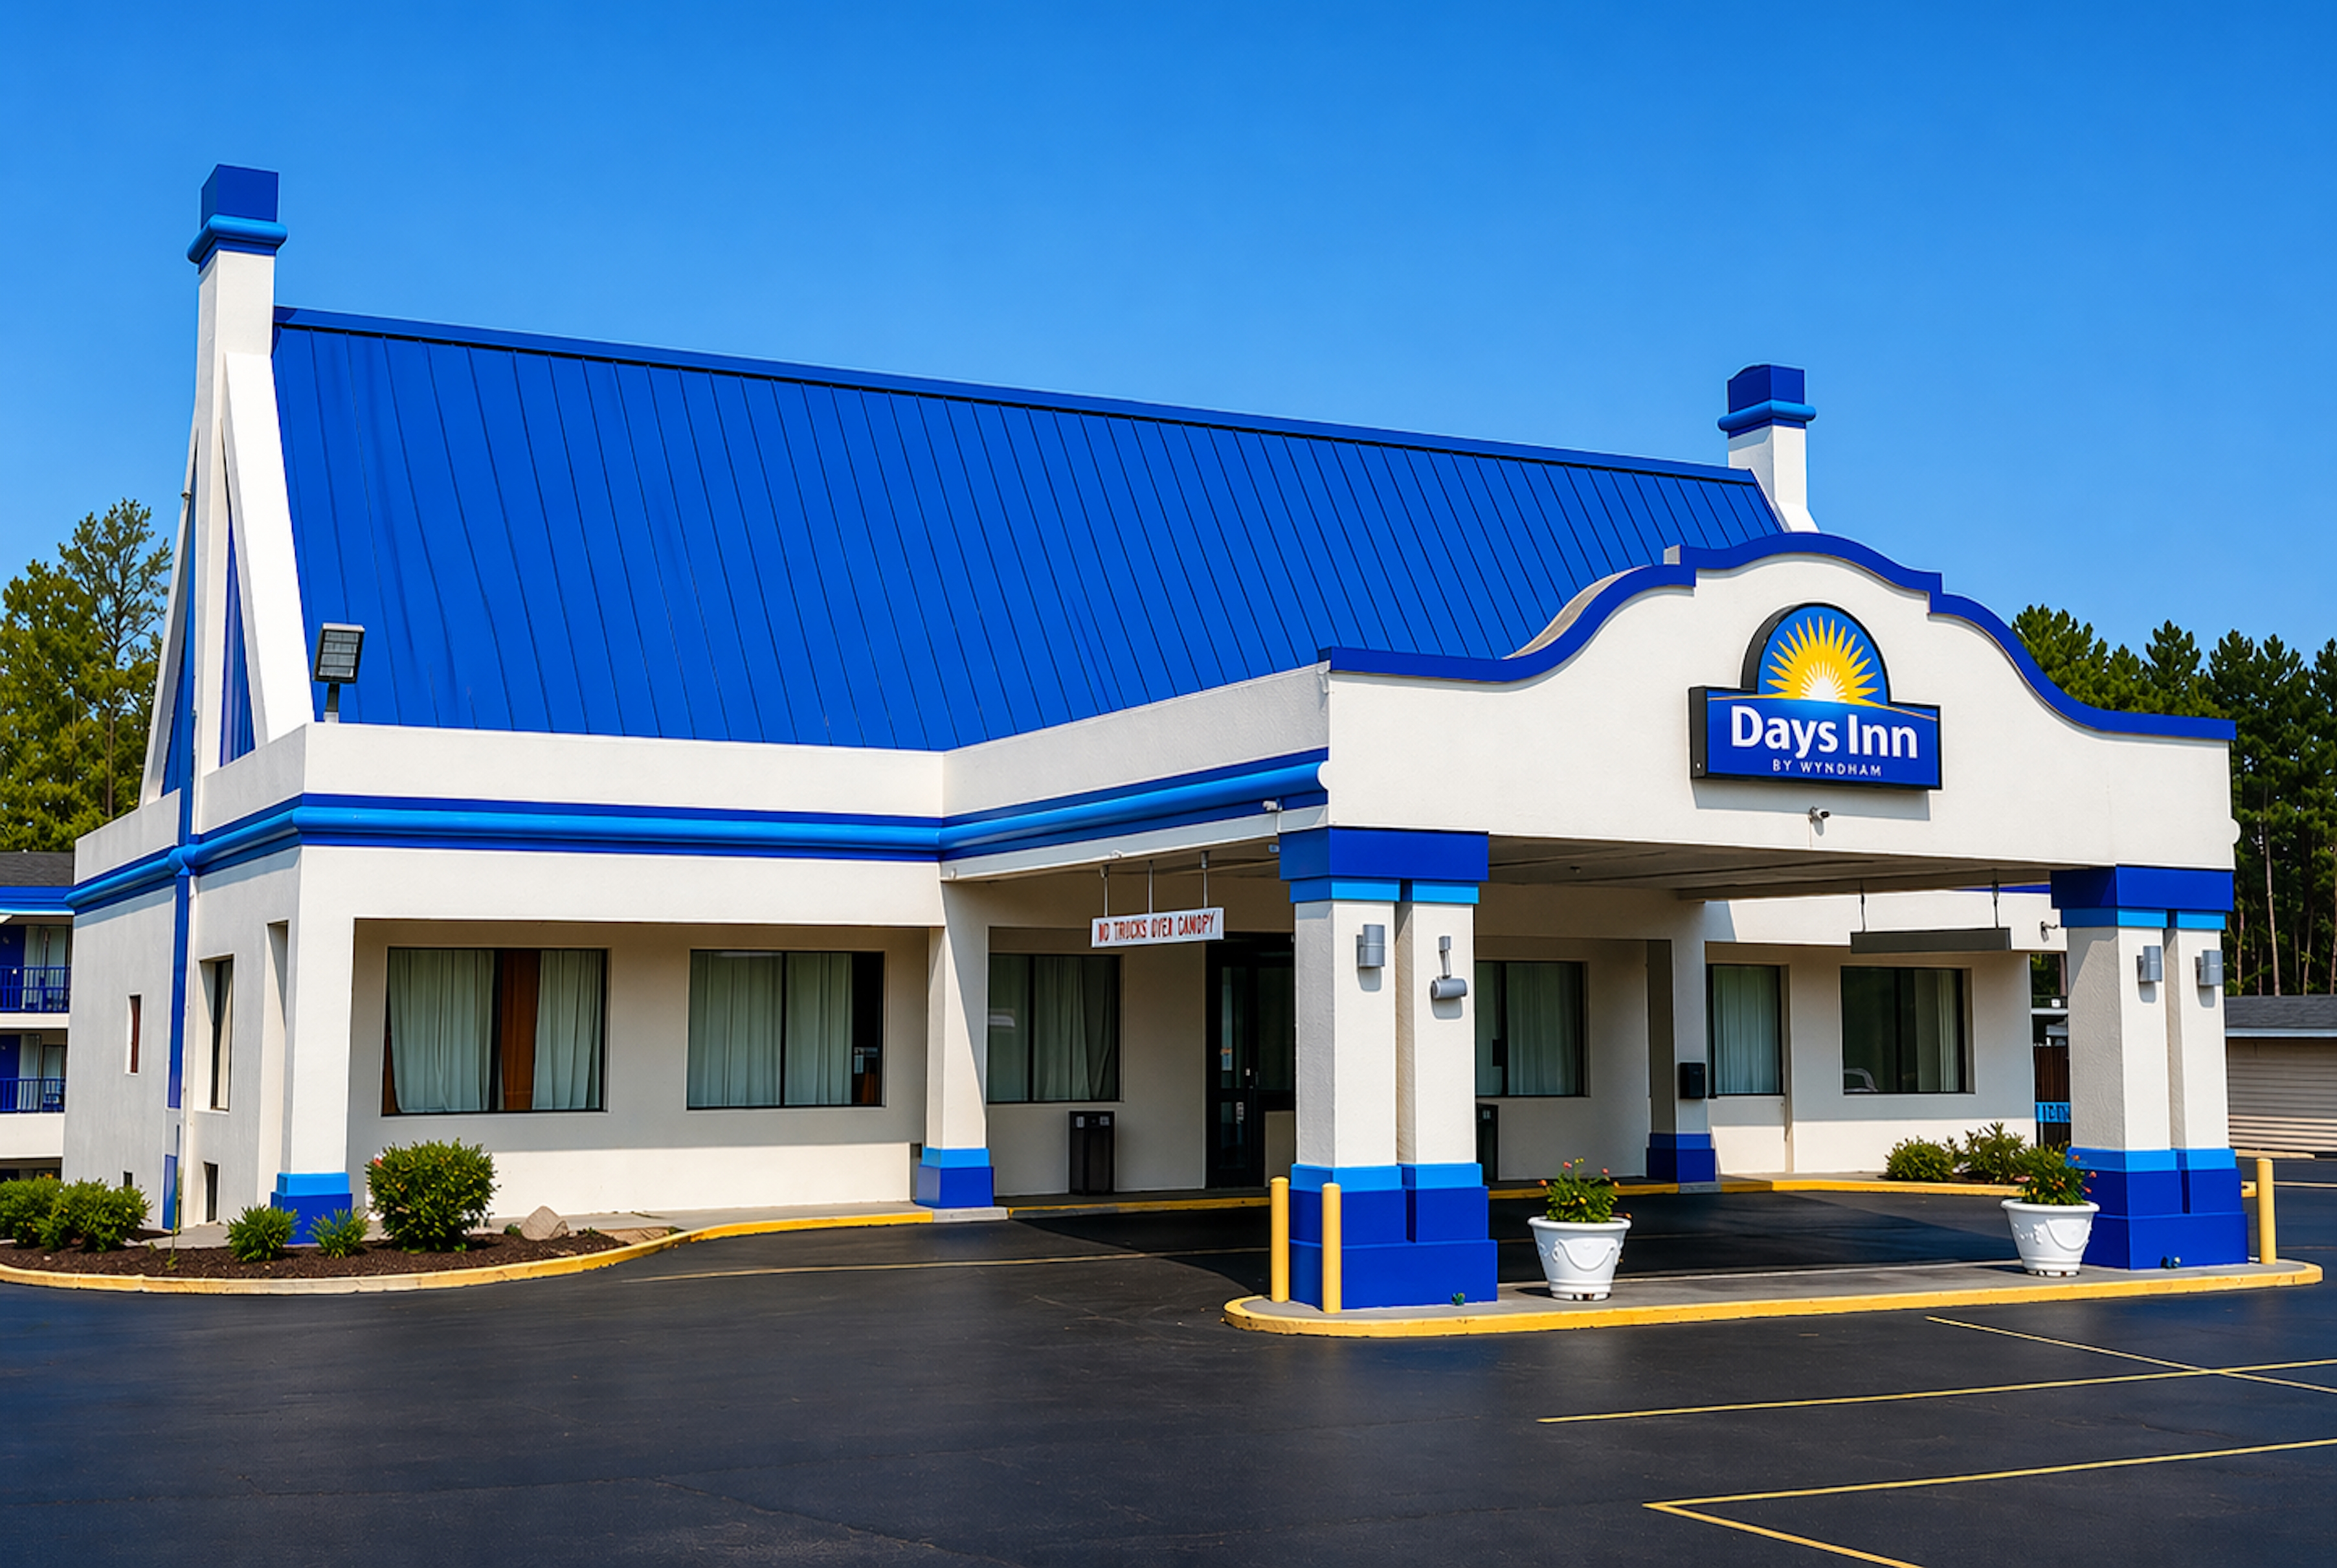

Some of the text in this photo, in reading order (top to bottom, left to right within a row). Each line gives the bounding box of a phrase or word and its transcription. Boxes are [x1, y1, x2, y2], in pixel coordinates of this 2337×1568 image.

[1730, 705, 1918, 759] Days Inn
[1772, 758, 1882, 777] BY WYNDHAM
[1099, 923, 1110, 942] NO
[1178, 911, 1216, 936] CANOPY
